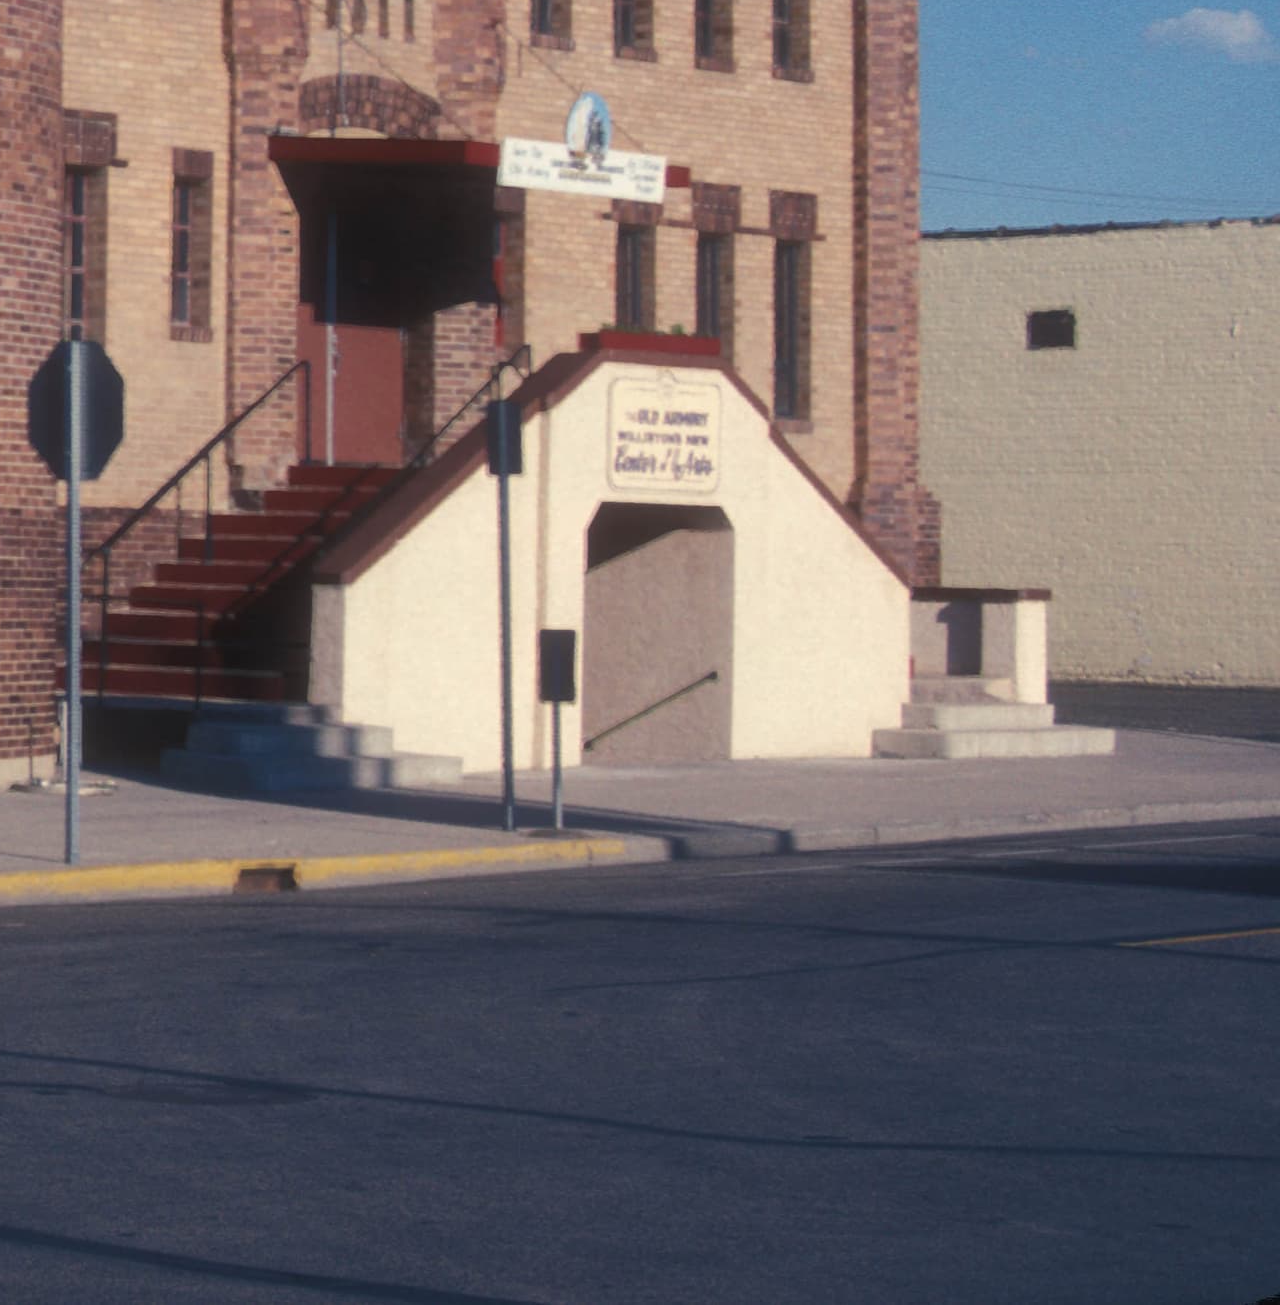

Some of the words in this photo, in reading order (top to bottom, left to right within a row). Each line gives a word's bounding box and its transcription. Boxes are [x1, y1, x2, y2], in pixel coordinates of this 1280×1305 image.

[637, 408, 660, 425] OLD
[663, 411, 709, 426] ARMORY
[685, 434, 709, 446] NEW
